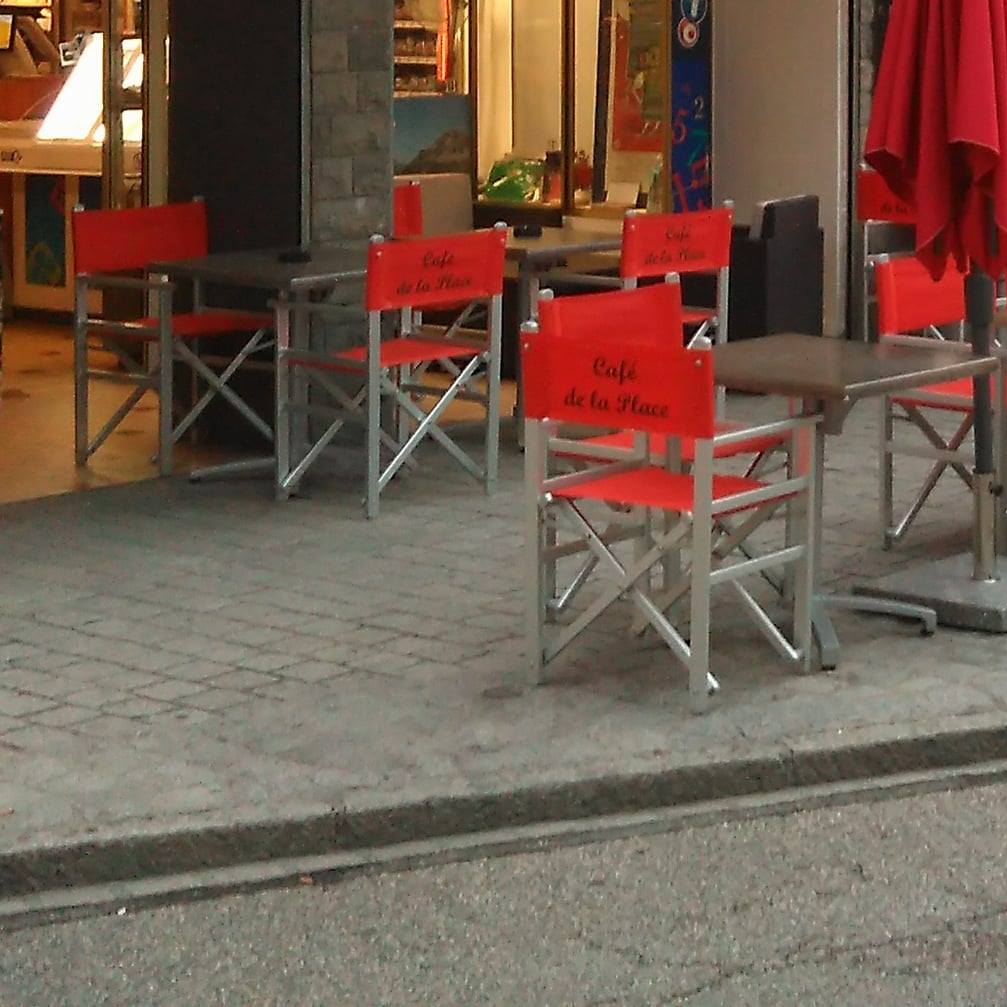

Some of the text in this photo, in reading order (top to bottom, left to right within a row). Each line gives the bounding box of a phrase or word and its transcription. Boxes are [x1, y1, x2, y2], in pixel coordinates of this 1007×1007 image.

[592, 355, 638, 386] Café
[563, 386, 670, 418] de la Place
